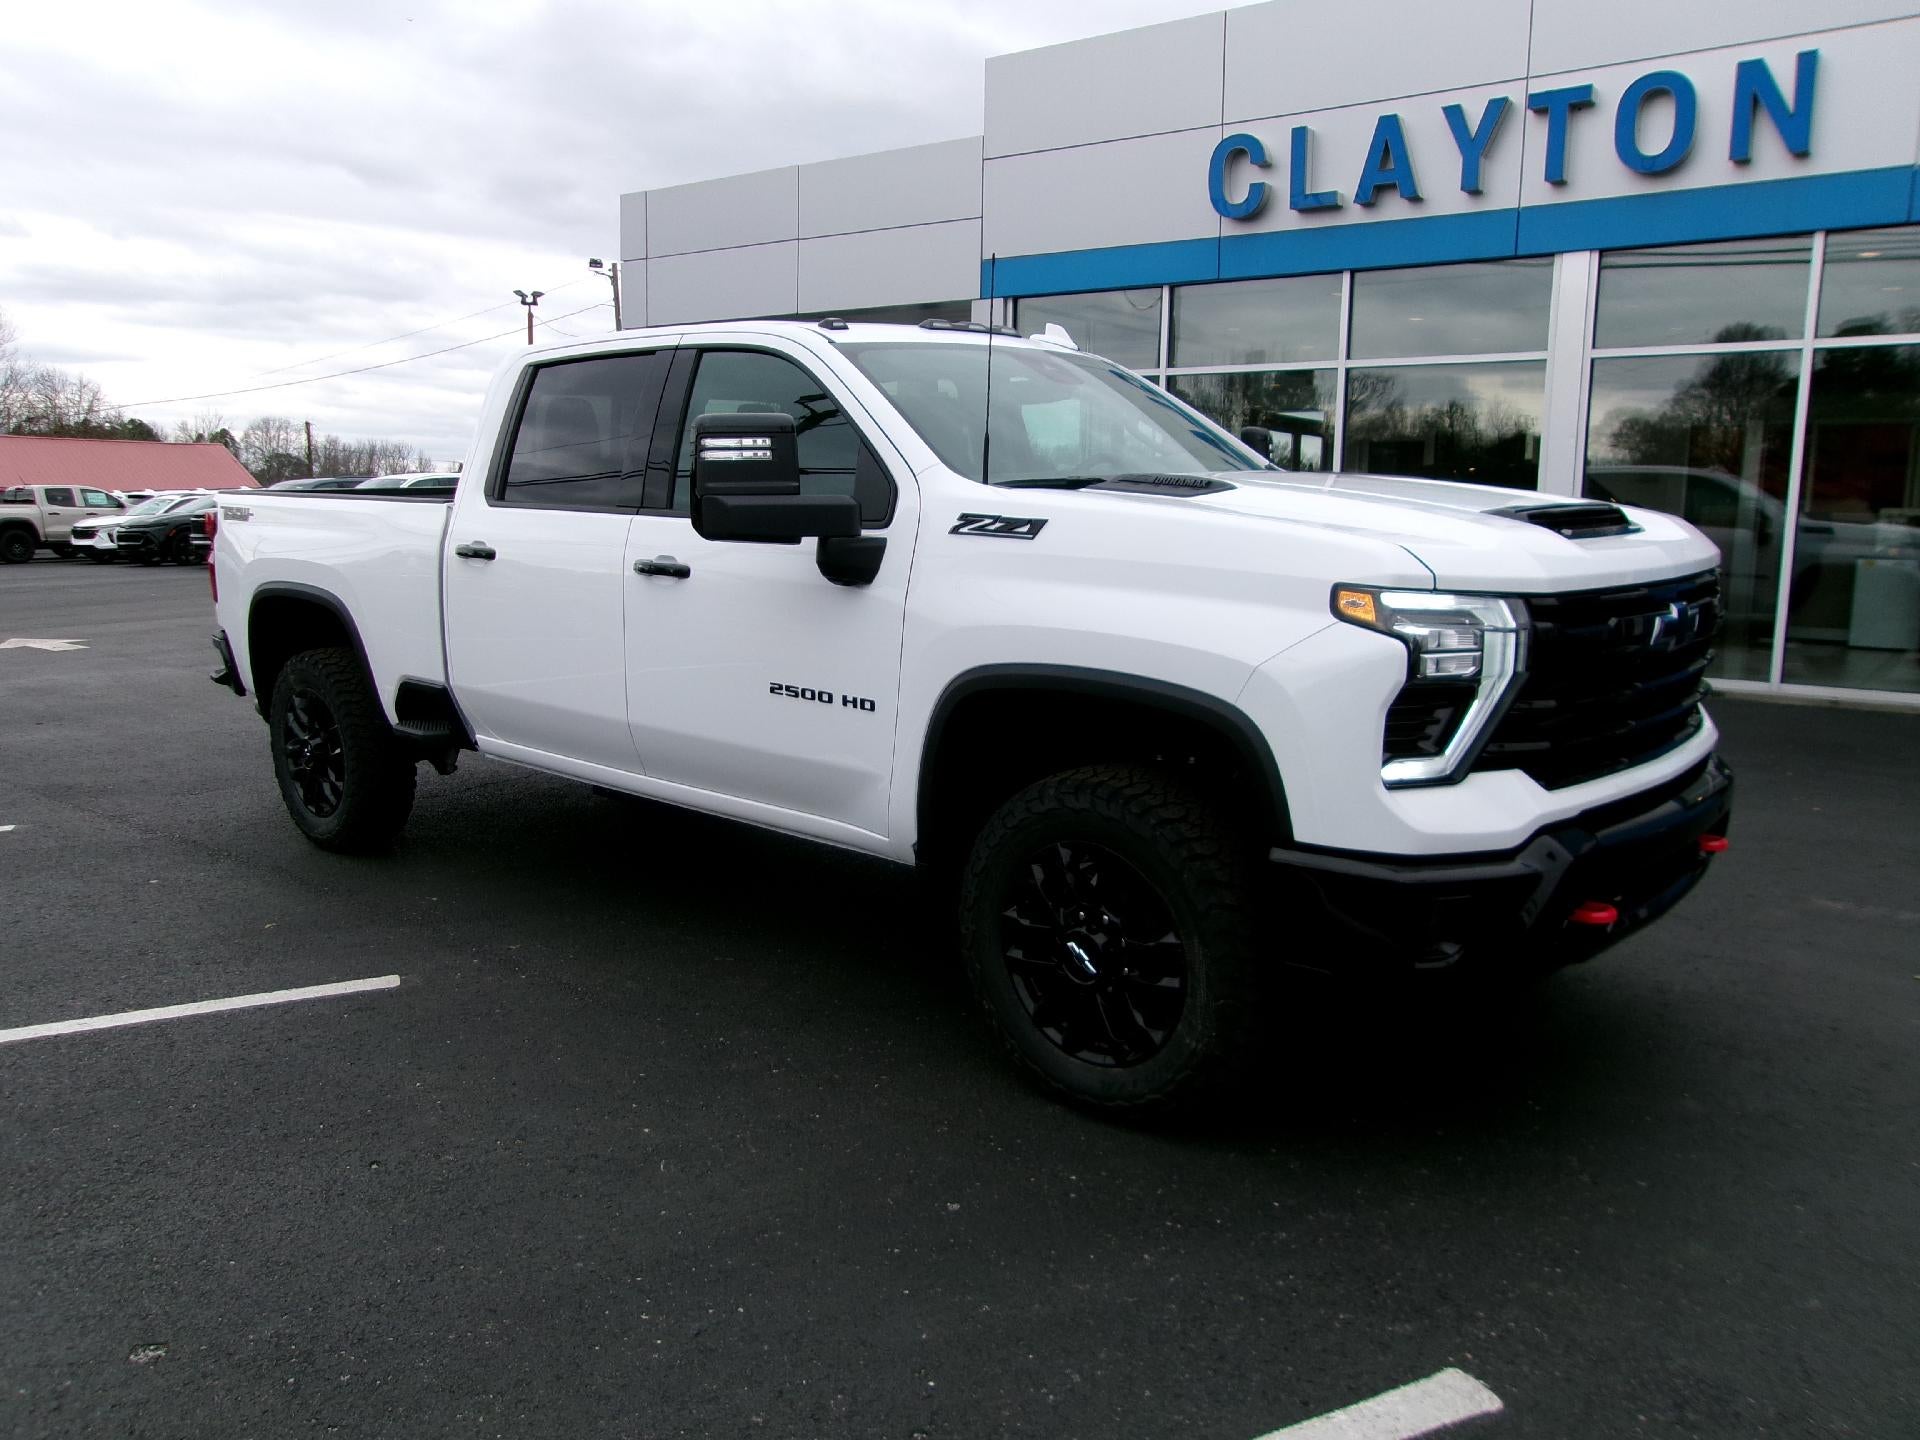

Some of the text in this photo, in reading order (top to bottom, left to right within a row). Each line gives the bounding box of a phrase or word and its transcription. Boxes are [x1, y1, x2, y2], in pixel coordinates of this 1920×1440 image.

[1208, 48, 1820, 221] CLAYTON
[769, 682, 876, 712] 2500 HD
